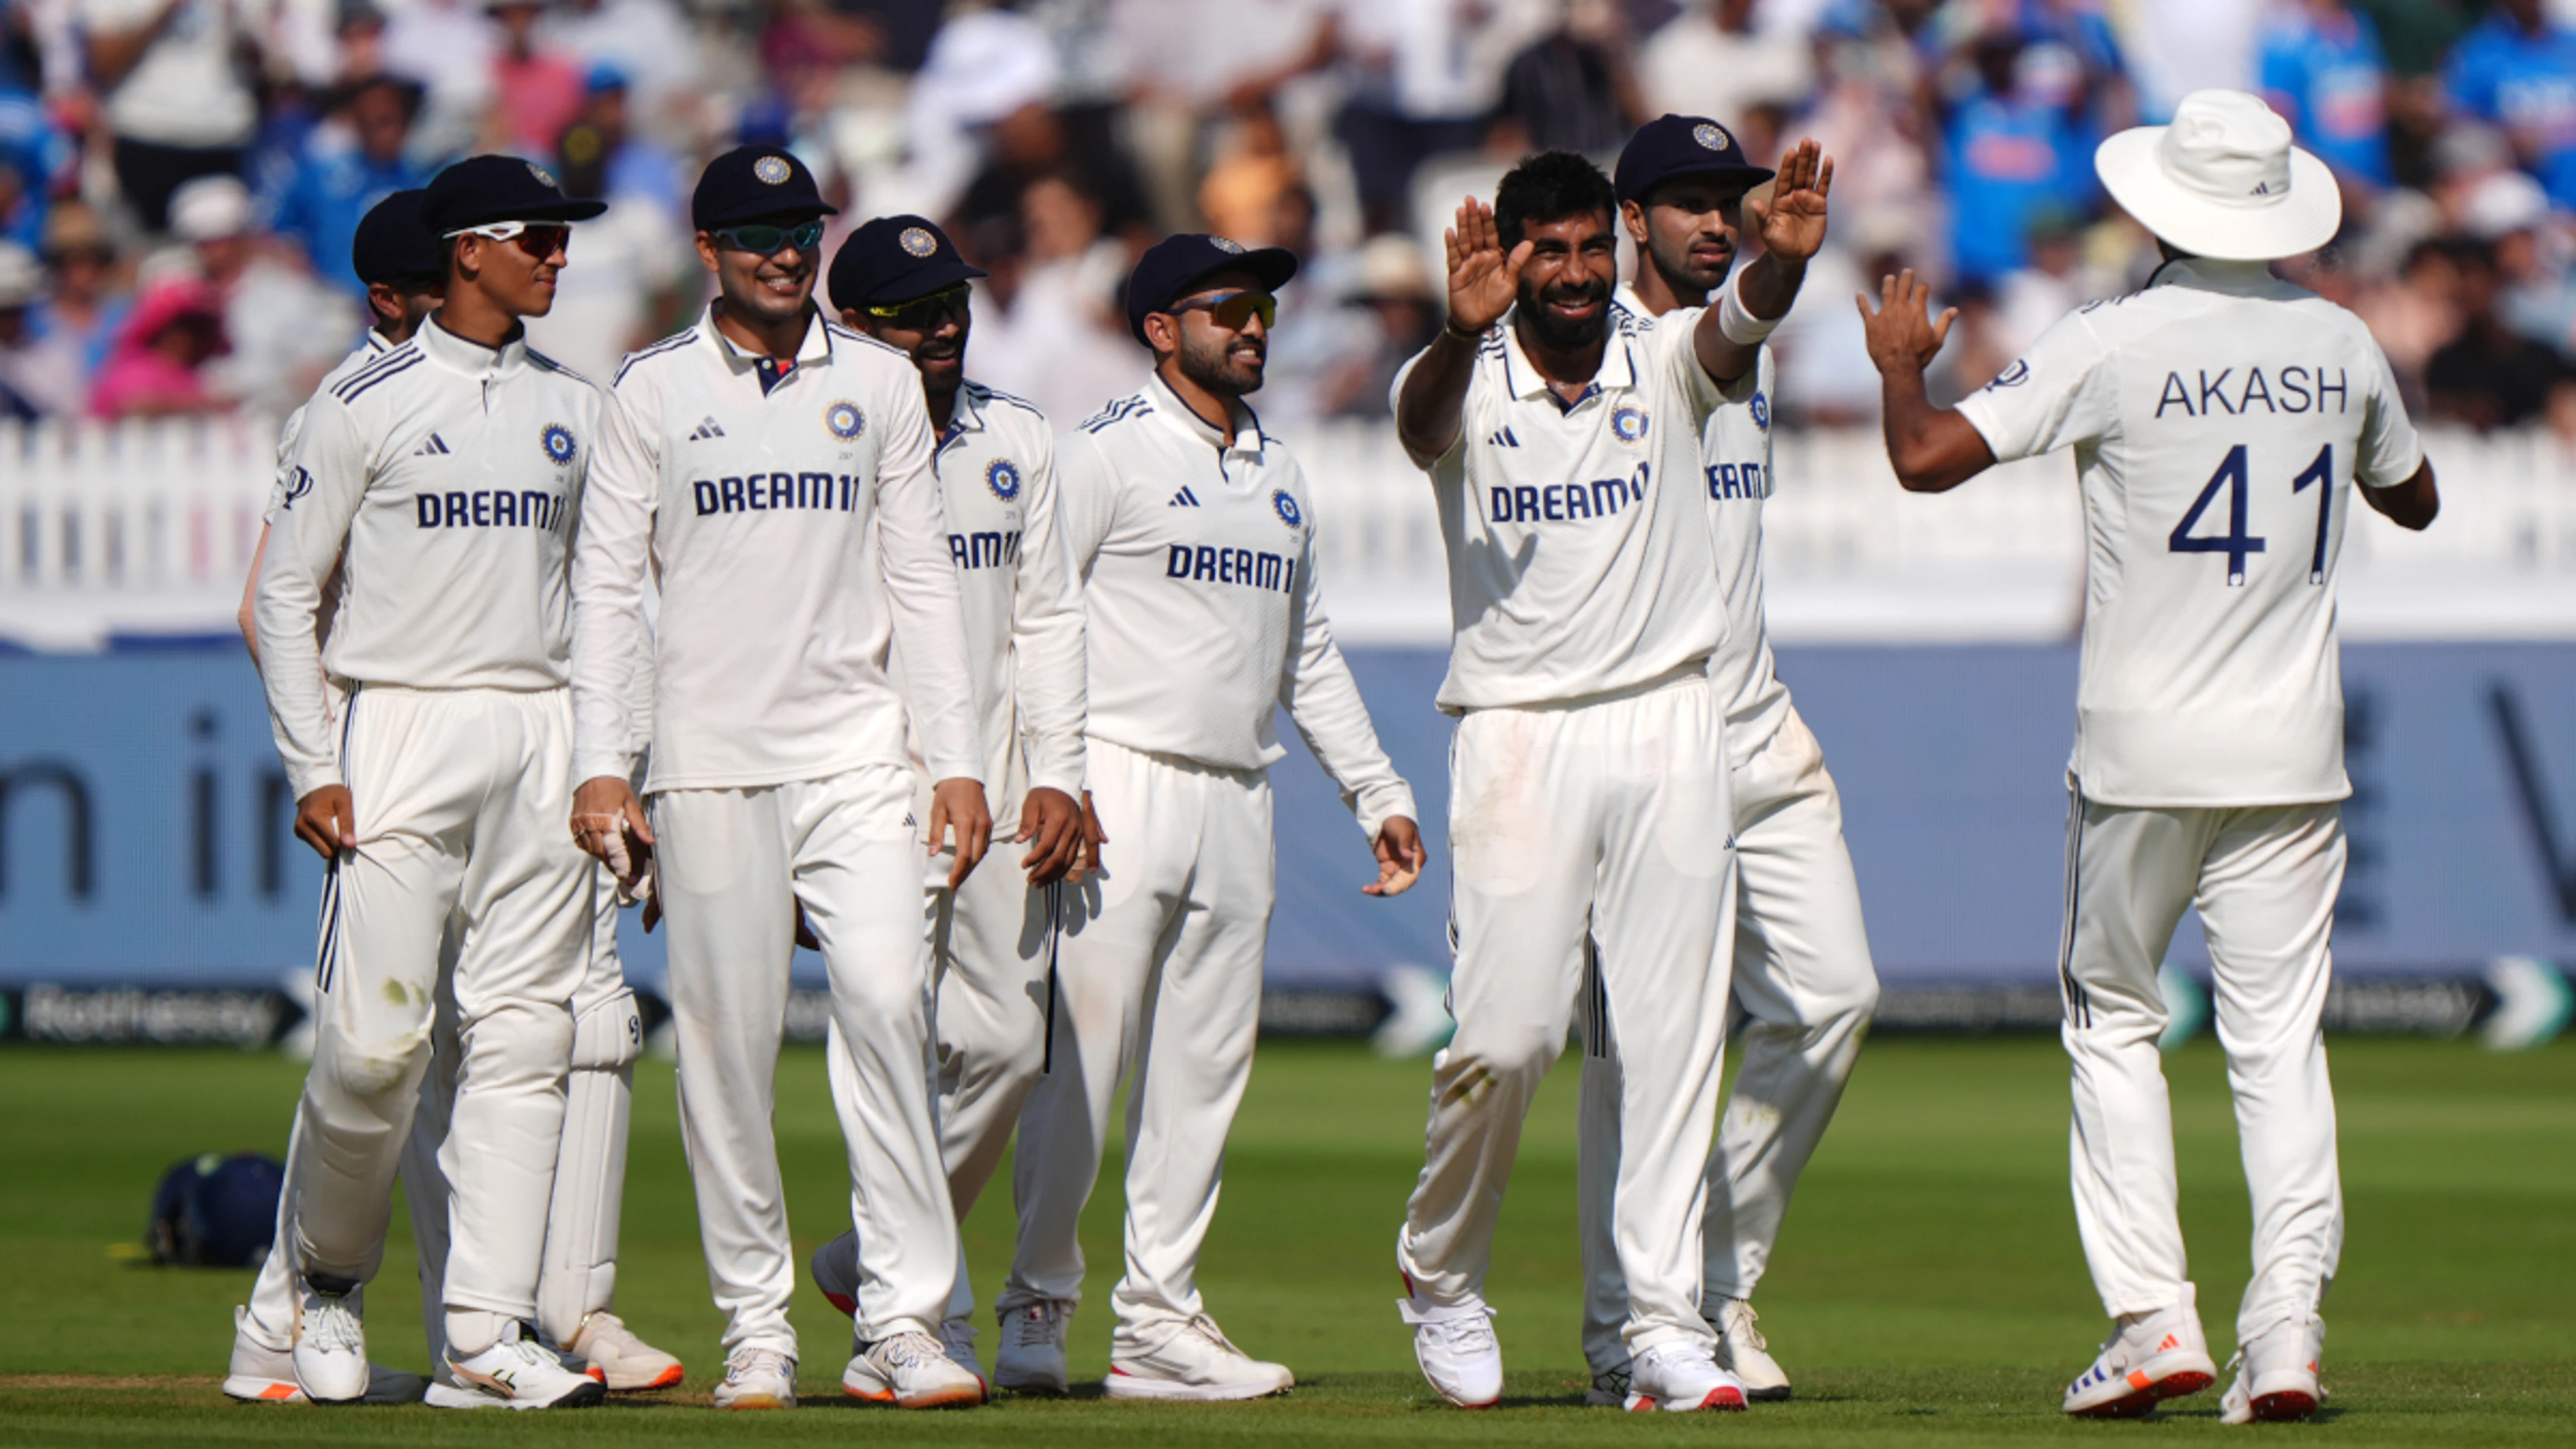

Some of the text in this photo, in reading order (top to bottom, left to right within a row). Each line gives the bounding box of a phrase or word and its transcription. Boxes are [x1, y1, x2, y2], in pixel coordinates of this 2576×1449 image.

[2155, 366, 2347, 418] AKASH
[693, 472, 860, 516] DREAM11
[2169, 443, 2334, 587] 41
[947, 531, 1021, 570] AM11
[1167, 544, 1295, 594] DREAM1
